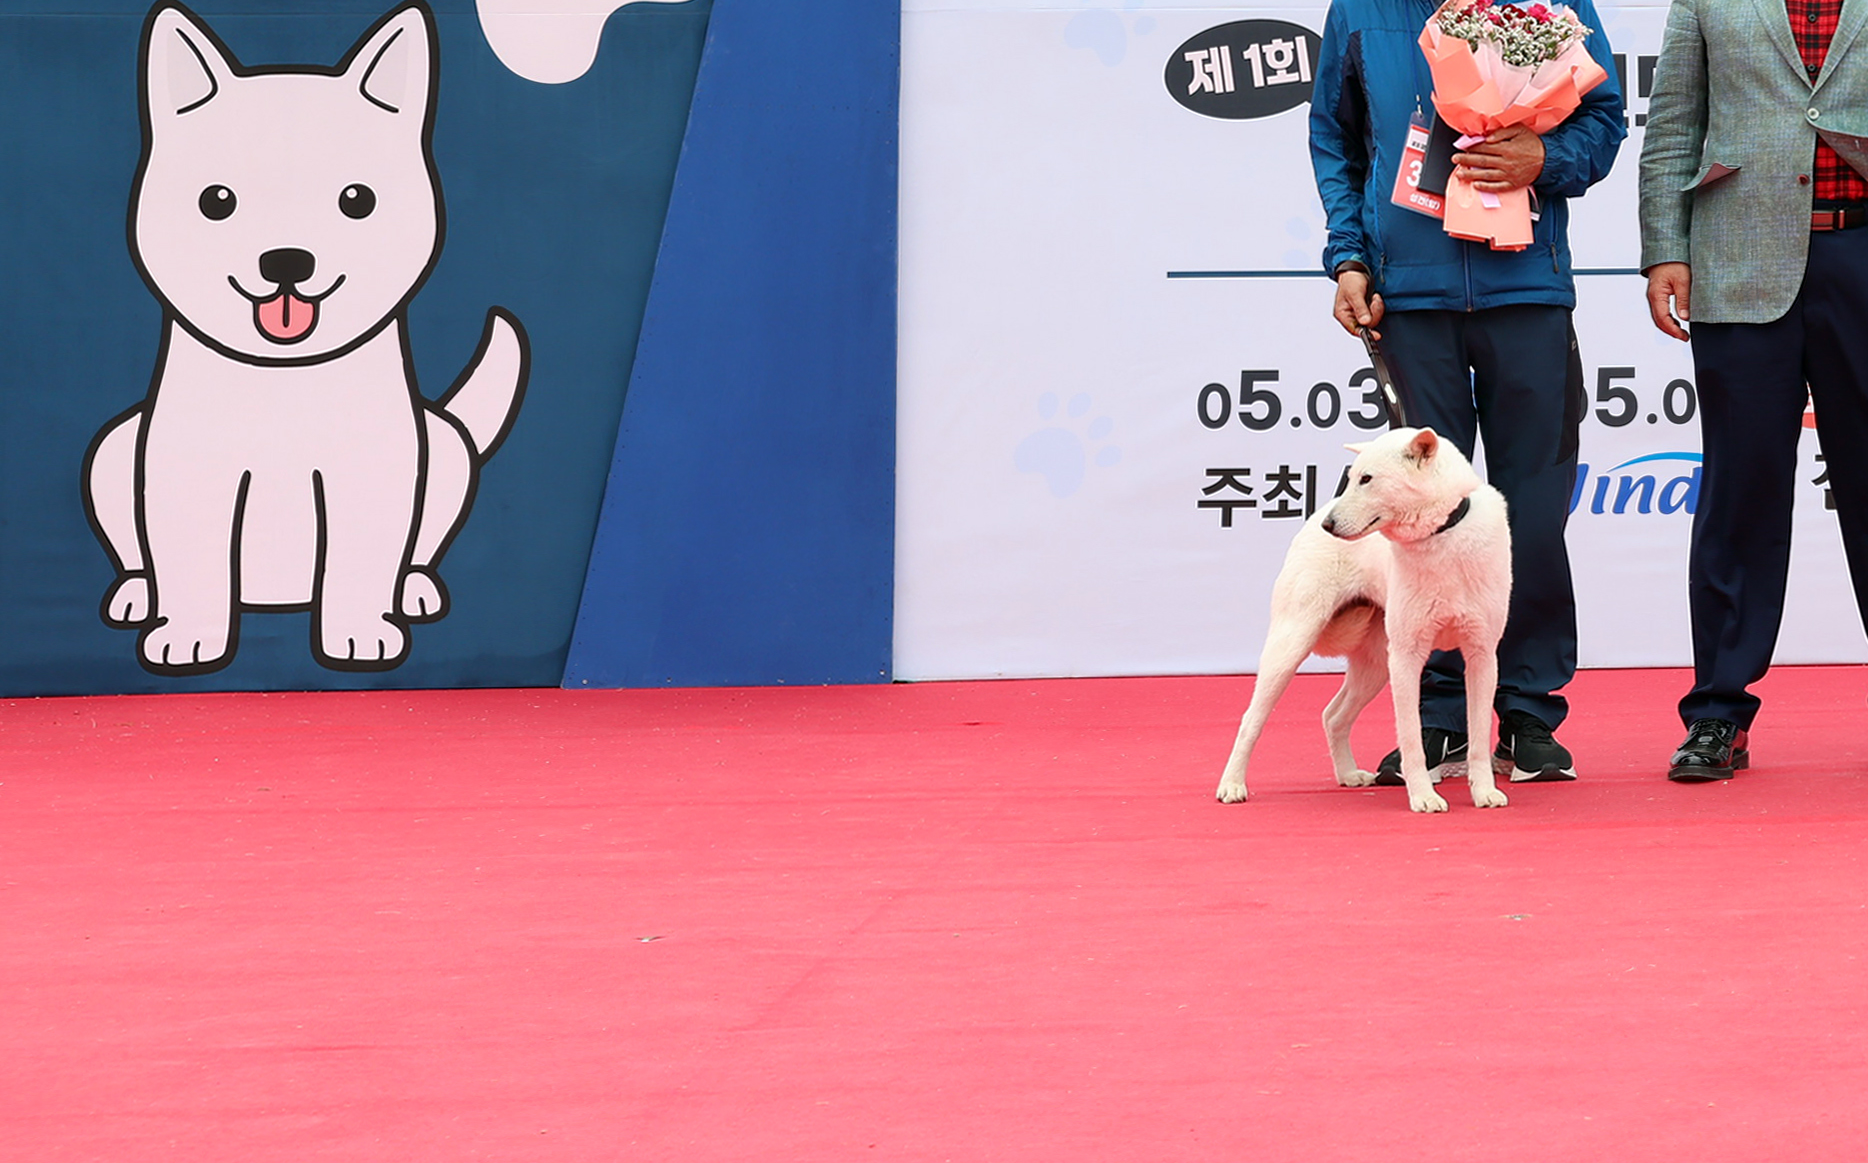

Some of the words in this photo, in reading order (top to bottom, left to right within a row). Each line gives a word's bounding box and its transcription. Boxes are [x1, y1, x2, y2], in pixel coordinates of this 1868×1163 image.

[1183, 44, 1236, 95] 제
[1241, 35, 1313, 89] 1회
[1197, 367, 1389, 430] 05.03
[1568, 462, 1703, 515] Jind
